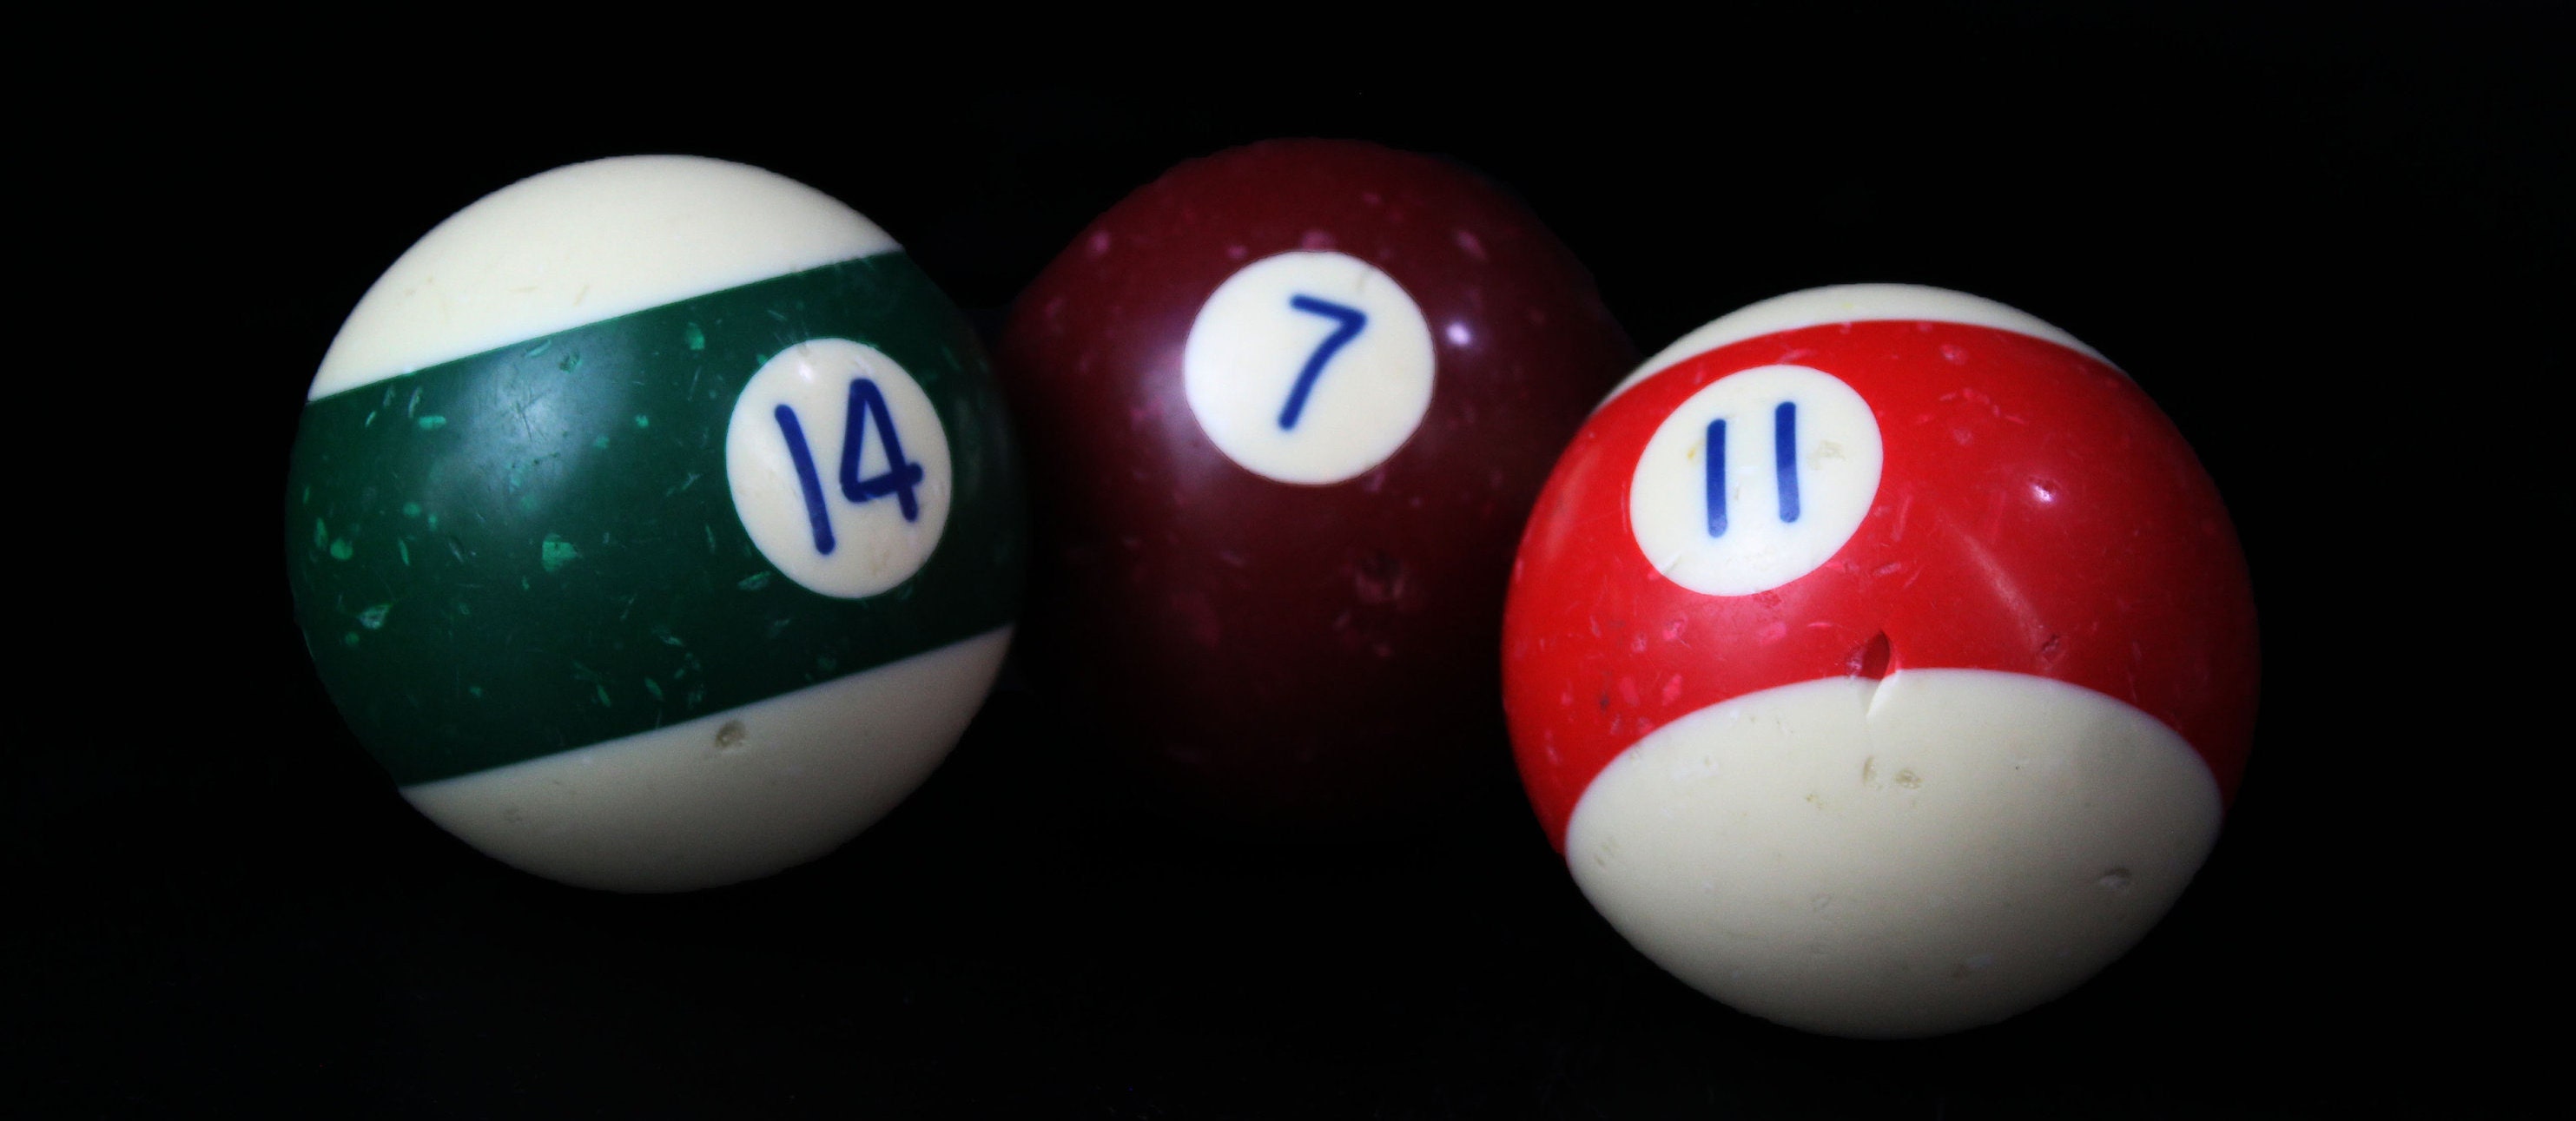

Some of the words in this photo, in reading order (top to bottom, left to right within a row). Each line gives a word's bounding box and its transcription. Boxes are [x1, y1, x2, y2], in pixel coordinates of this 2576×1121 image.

[1277, 293, 1370, 432] 7
[774, 377, 924, 556] 14
[1703, 401, 1800, 538] 11
